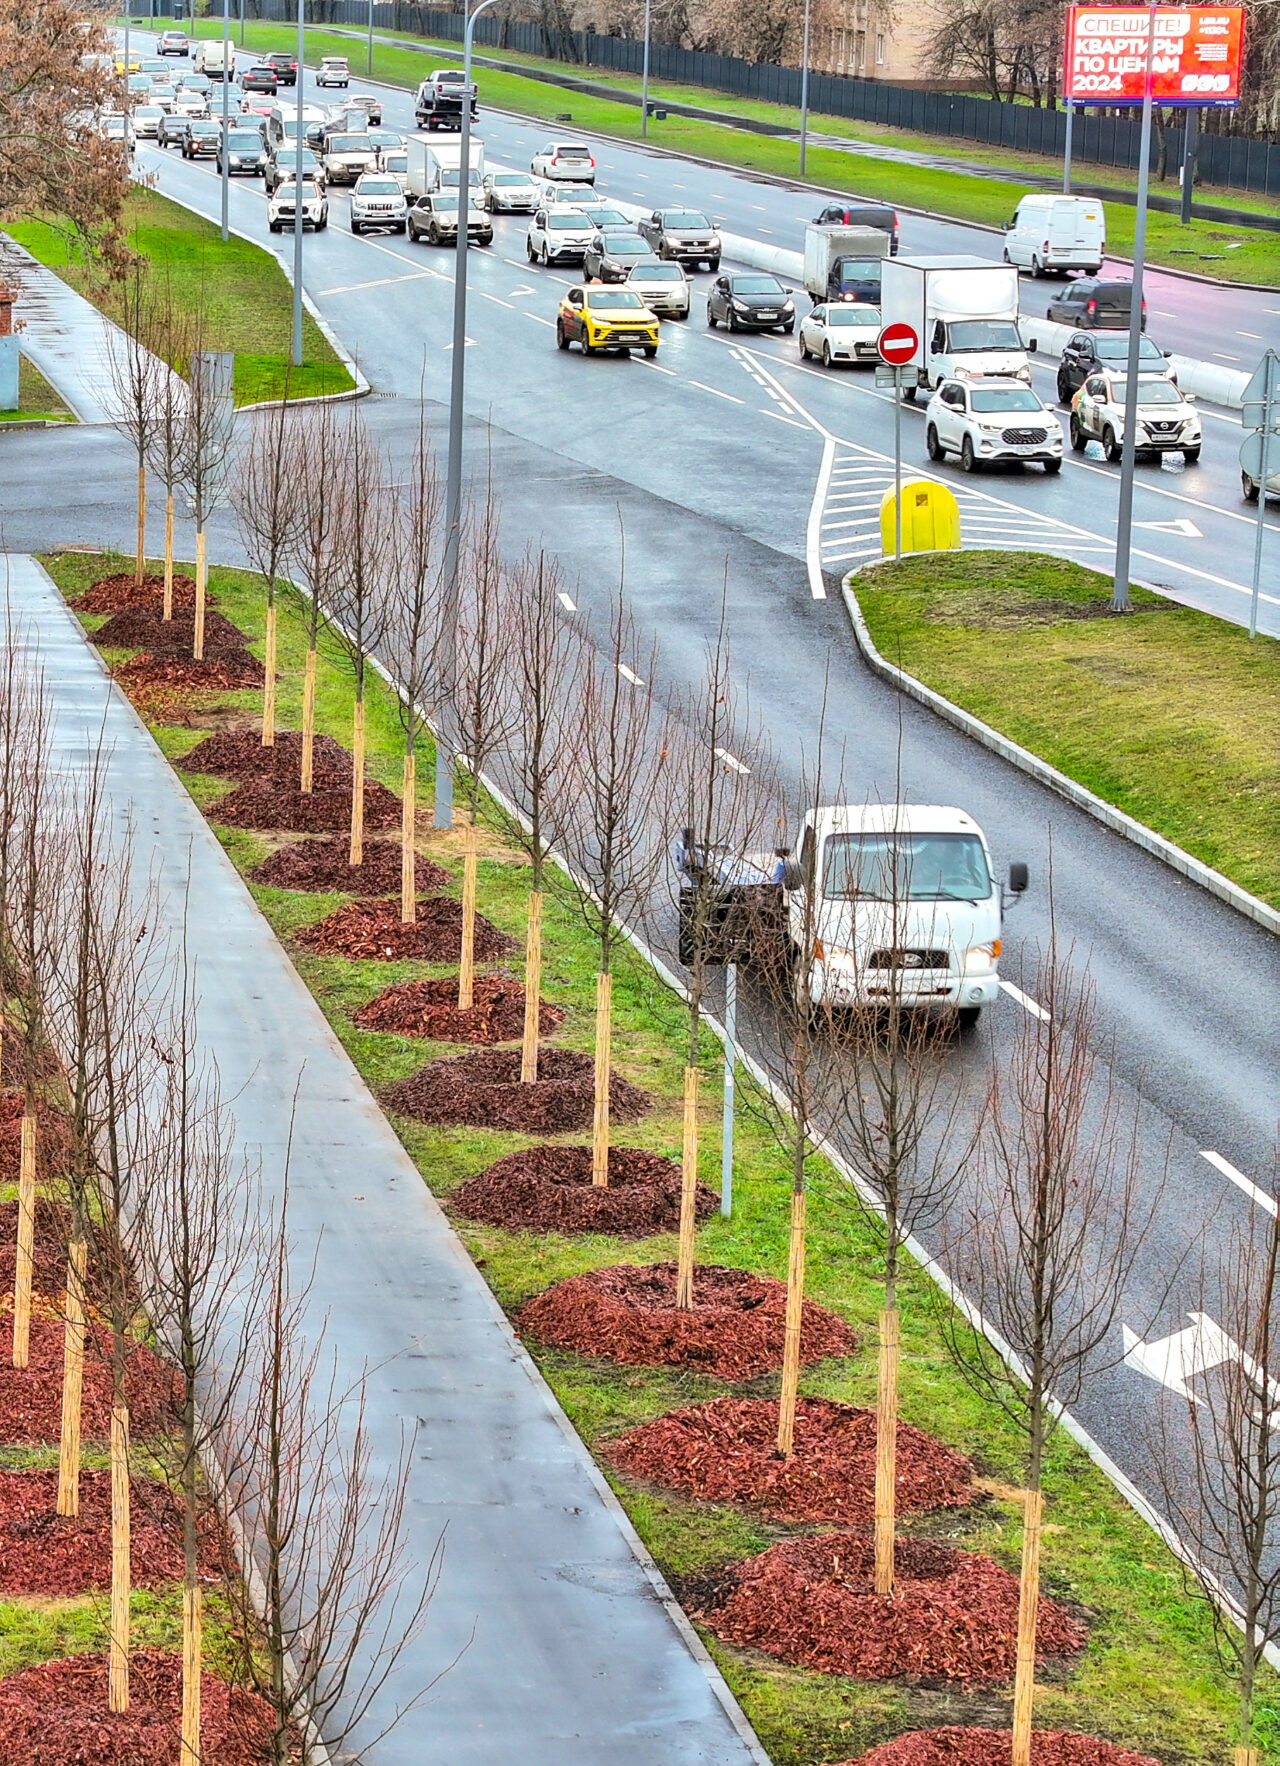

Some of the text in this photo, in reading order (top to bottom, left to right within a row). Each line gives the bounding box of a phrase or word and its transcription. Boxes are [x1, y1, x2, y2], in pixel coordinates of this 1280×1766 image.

[1084, 18, 1182, 32] СПЕШИТЕ!
[1075, 38, 1184, 55] КВАРТИРЫ
[1074, 56, 1180, 75] ПО ЦЕНАМ
[1072, 74, 1123, 91] 2024
